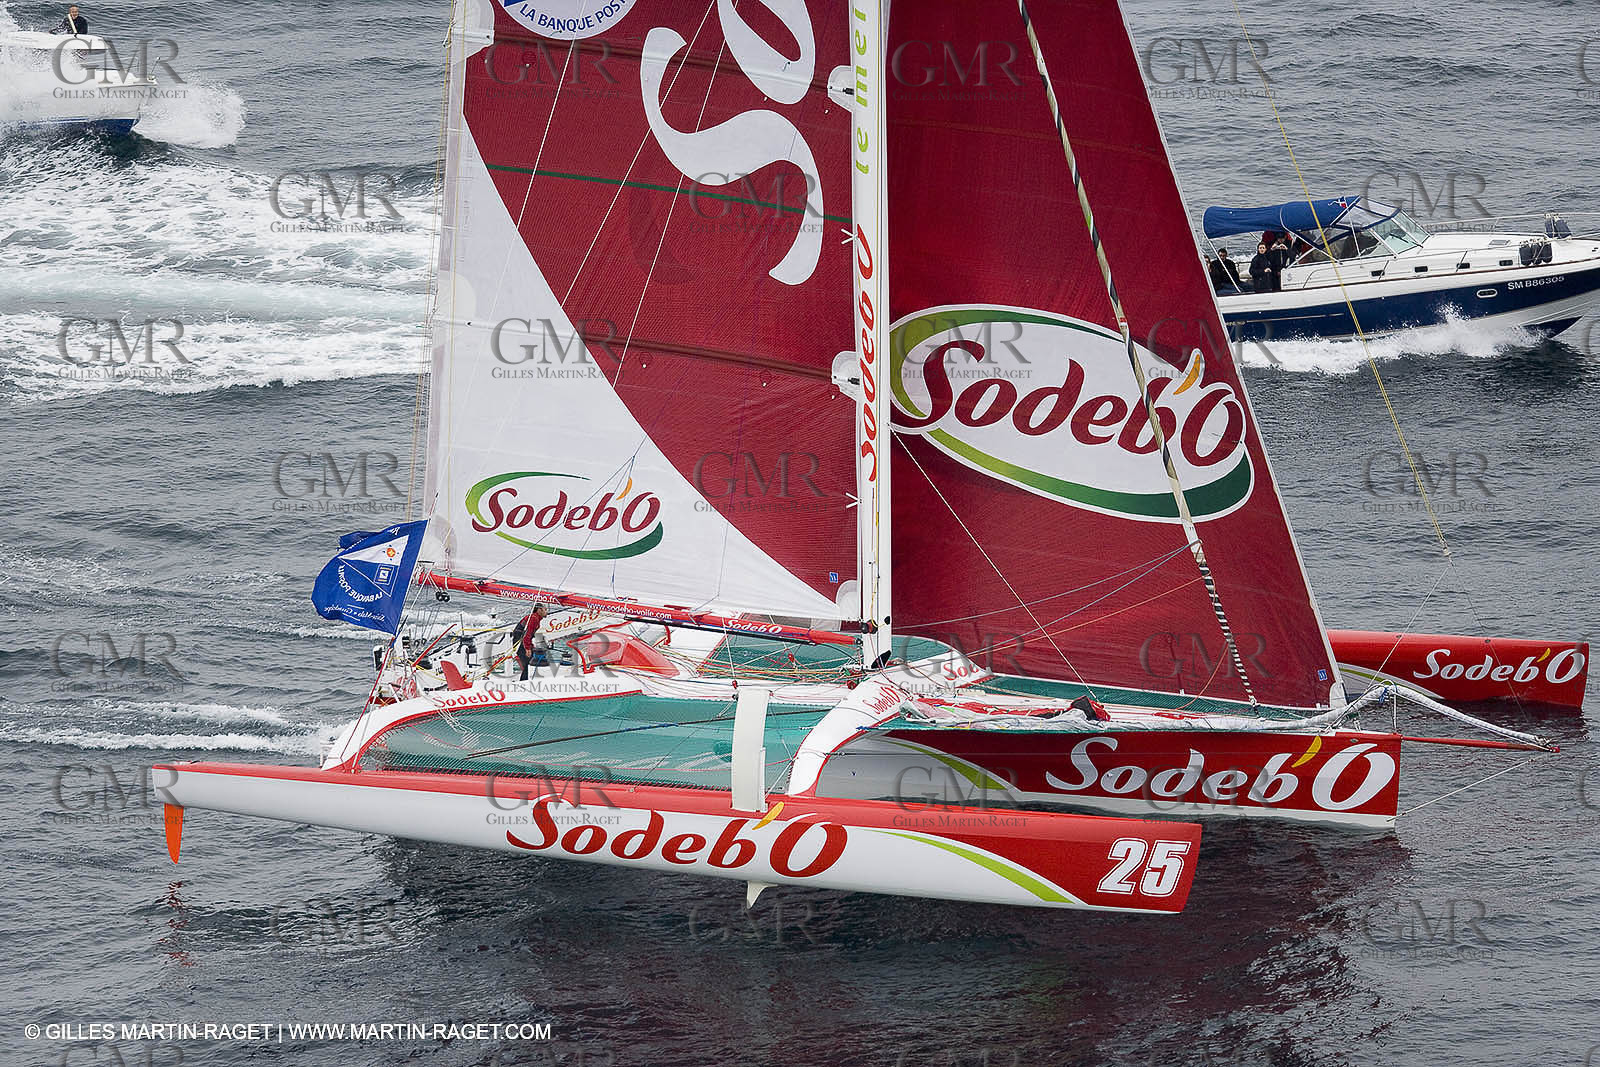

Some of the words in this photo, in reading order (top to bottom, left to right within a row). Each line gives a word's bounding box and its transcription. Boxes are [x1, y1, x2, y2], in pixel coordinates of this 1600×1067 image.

[519, 3, 536, 21] LA
[538, 14, 594, 32] BANQUE
[1507, 281, 1524, 290] SM
[890, 340, 1244, 467] Sodeb'O
[471, 477, 661, 533] Sodeb'O
[1413, 647, 1585, 684] Sodeb'O
[1045, 735, 1396, 811] Sodeb'O
[506, 793, 849, 879] Sodeb'O
[1096, 838, 1192, 897] 25
